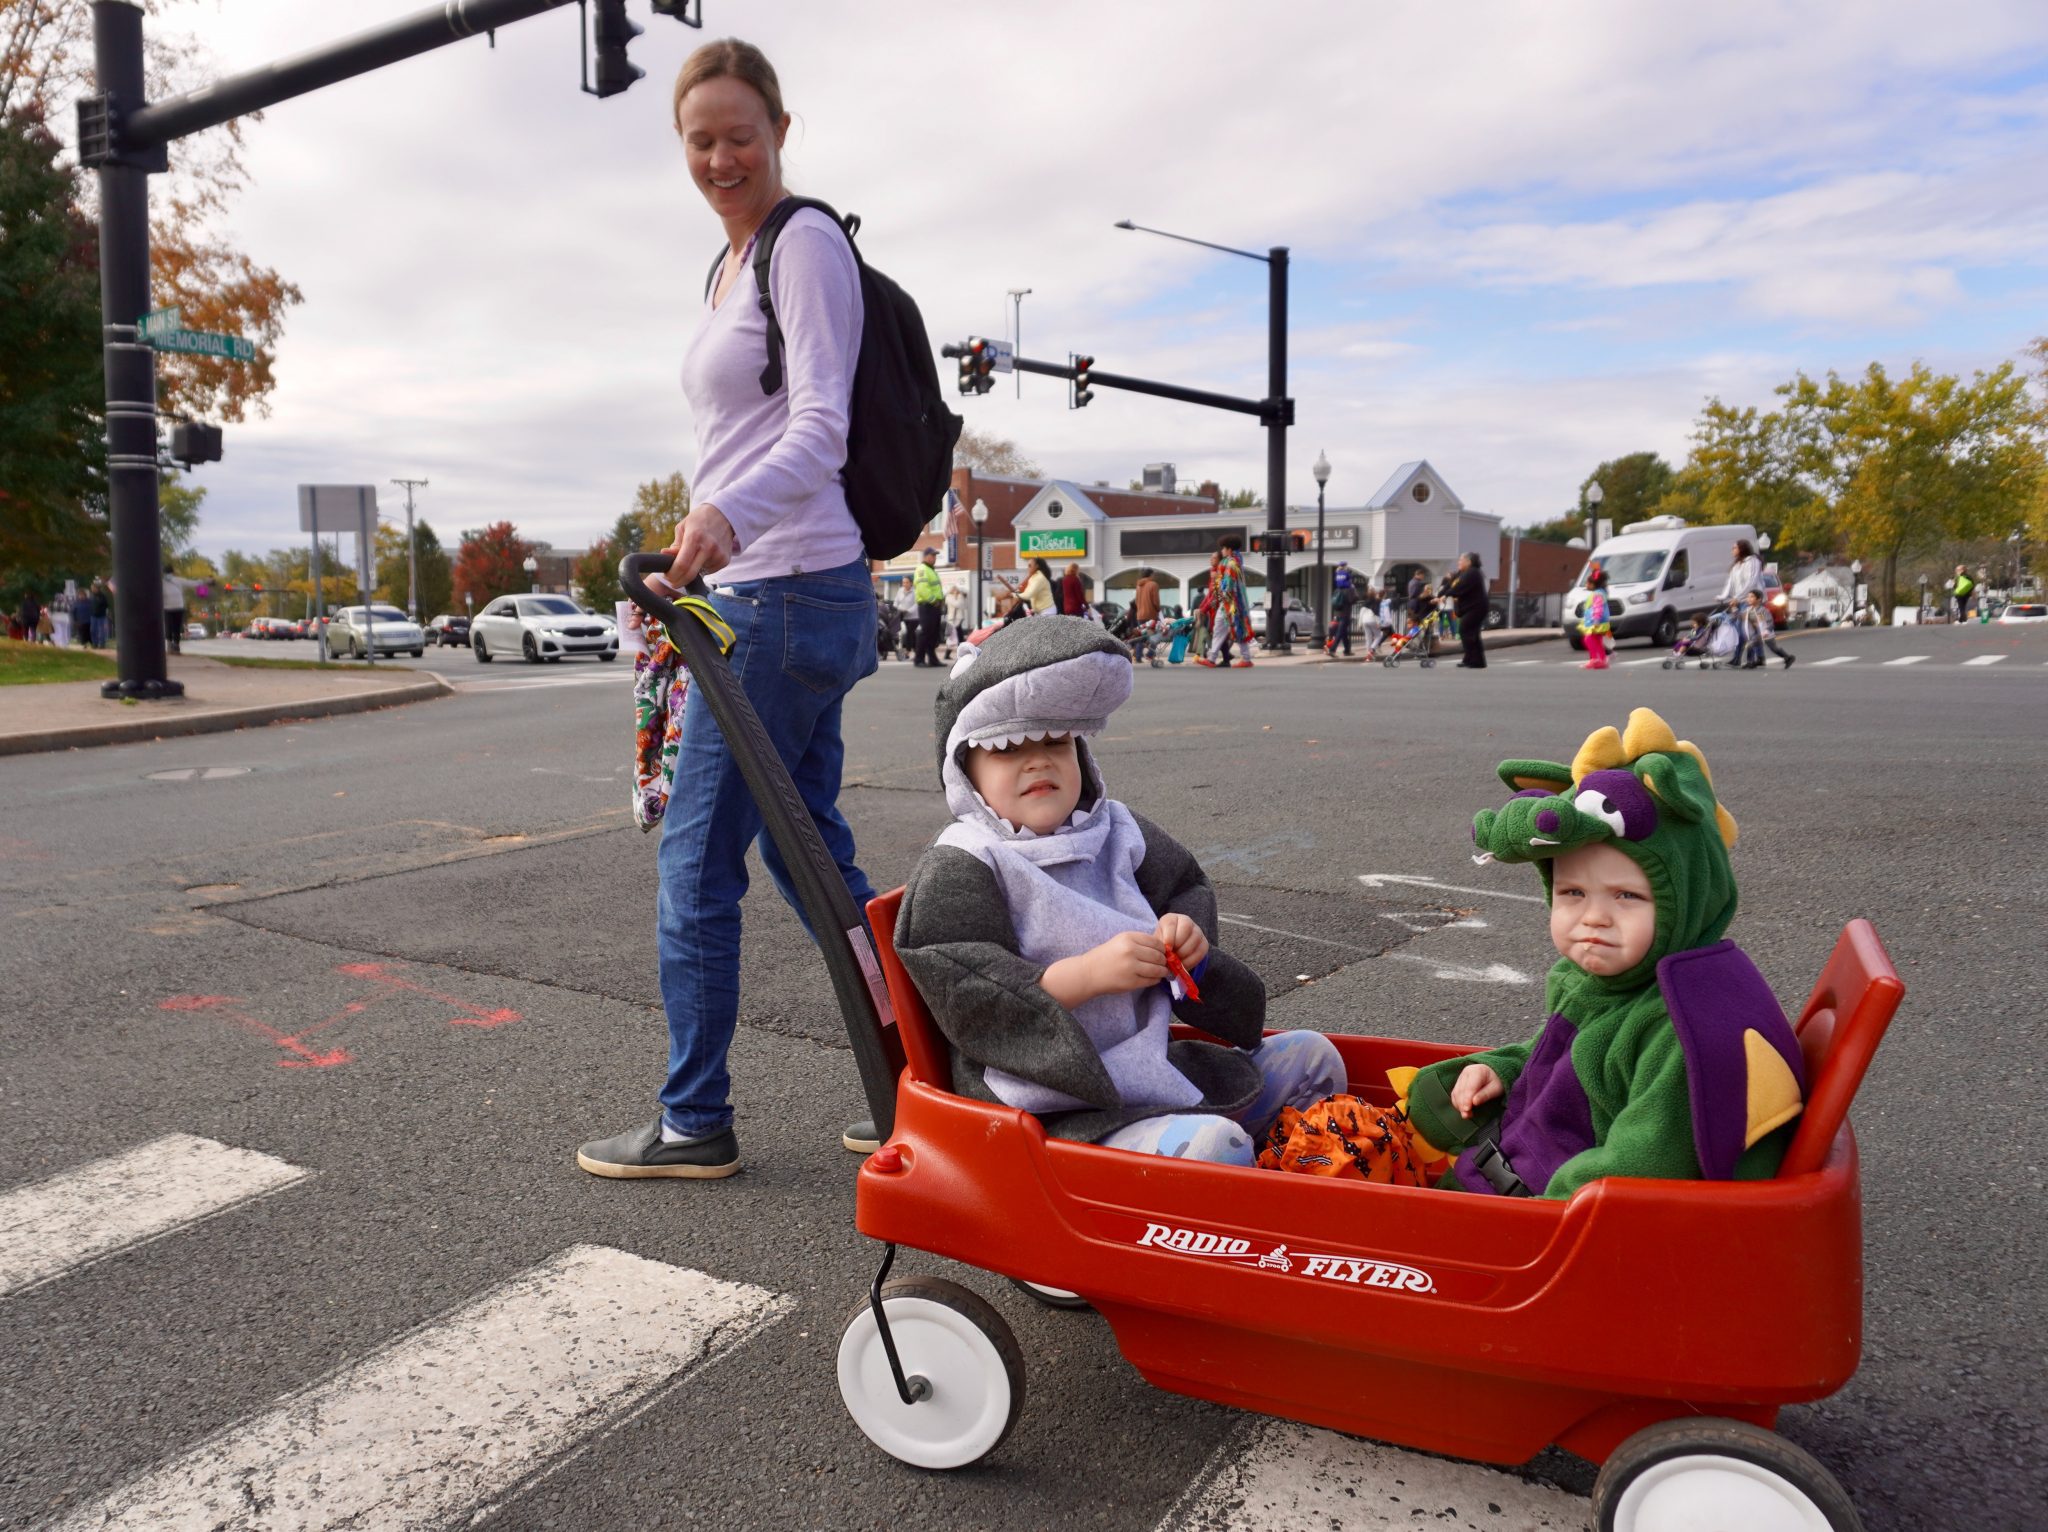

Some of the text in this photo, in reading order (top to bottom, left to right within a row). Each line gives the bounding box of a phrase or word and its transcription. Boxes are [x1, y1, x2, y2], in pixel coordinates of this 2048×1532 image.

[146, 312, 165, 337] MAIN
[155, 329, 252, 358] MEMORIAL RD
[1136, 1222, 1433, 1293] RADIO FLYER
